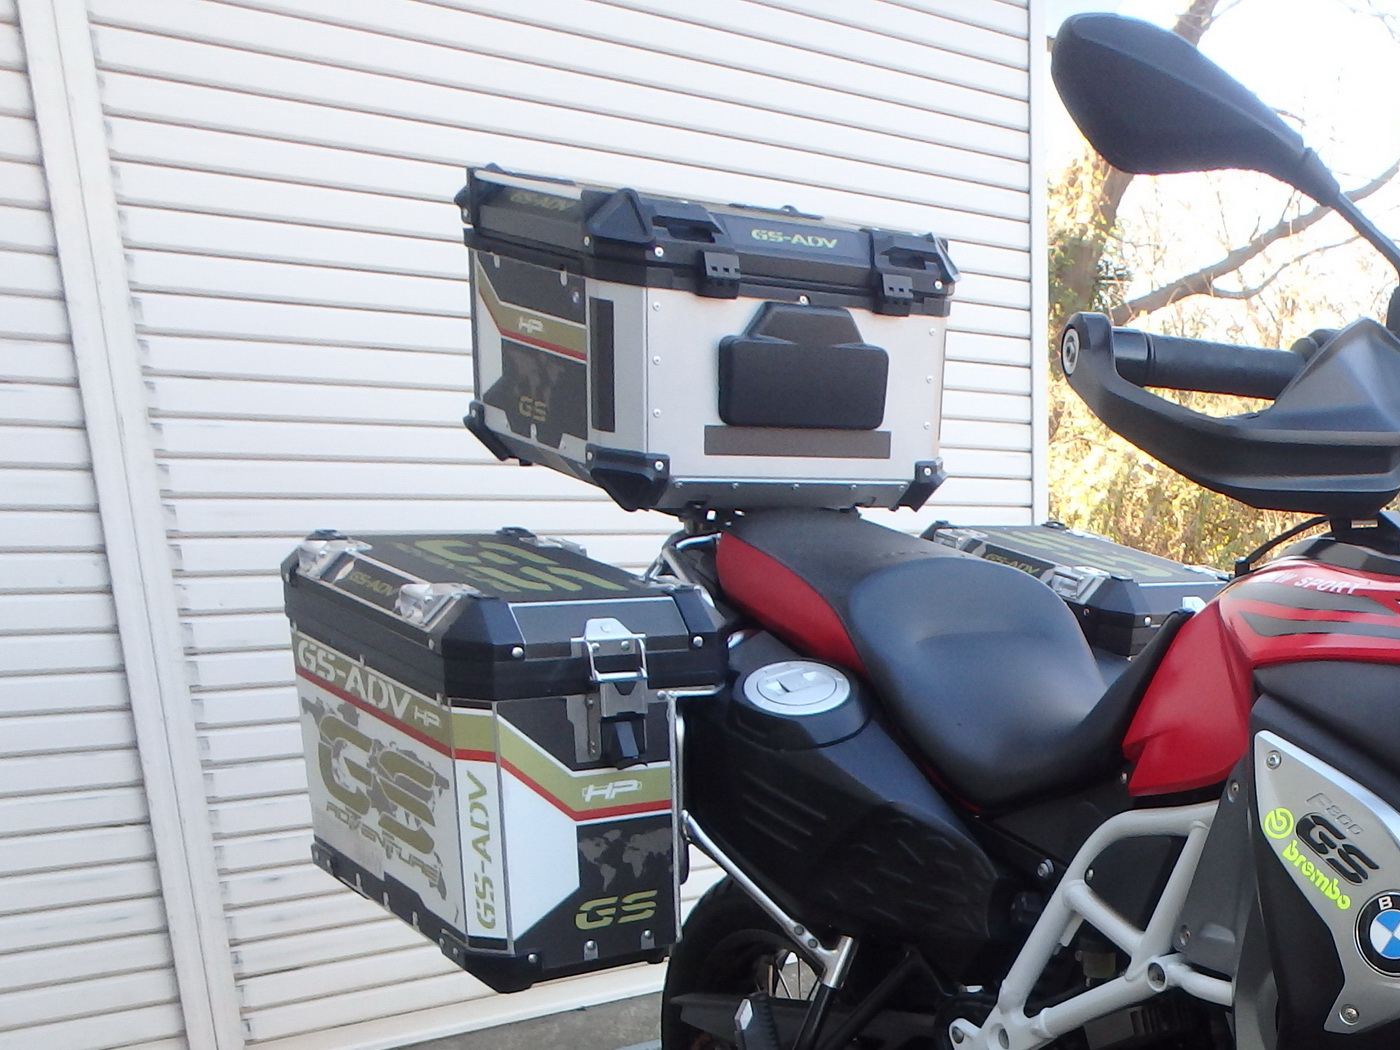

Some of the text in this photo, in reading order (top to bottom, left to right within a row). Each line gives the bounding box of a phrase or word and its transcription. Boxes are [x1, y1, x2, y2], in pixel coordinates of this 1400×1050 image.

[751, 229, 838, 249] GS-ADV
[518, 395, 547, 421] GS
[1294, 576, 1363, 594] SPORT
[298, 639, 412, 720] GS-ADV
[318, 713, 437, 855] GS
[581, 779, 643, 803] HP
[326, 800, 440, 886] ADVENTURE
[467, 770, 497, 930] GS-ADV
[1281, 839, 1352, 910] brembo
[1295, 812, 1380, 884] GS
[574, 889, 658, 931] GS
